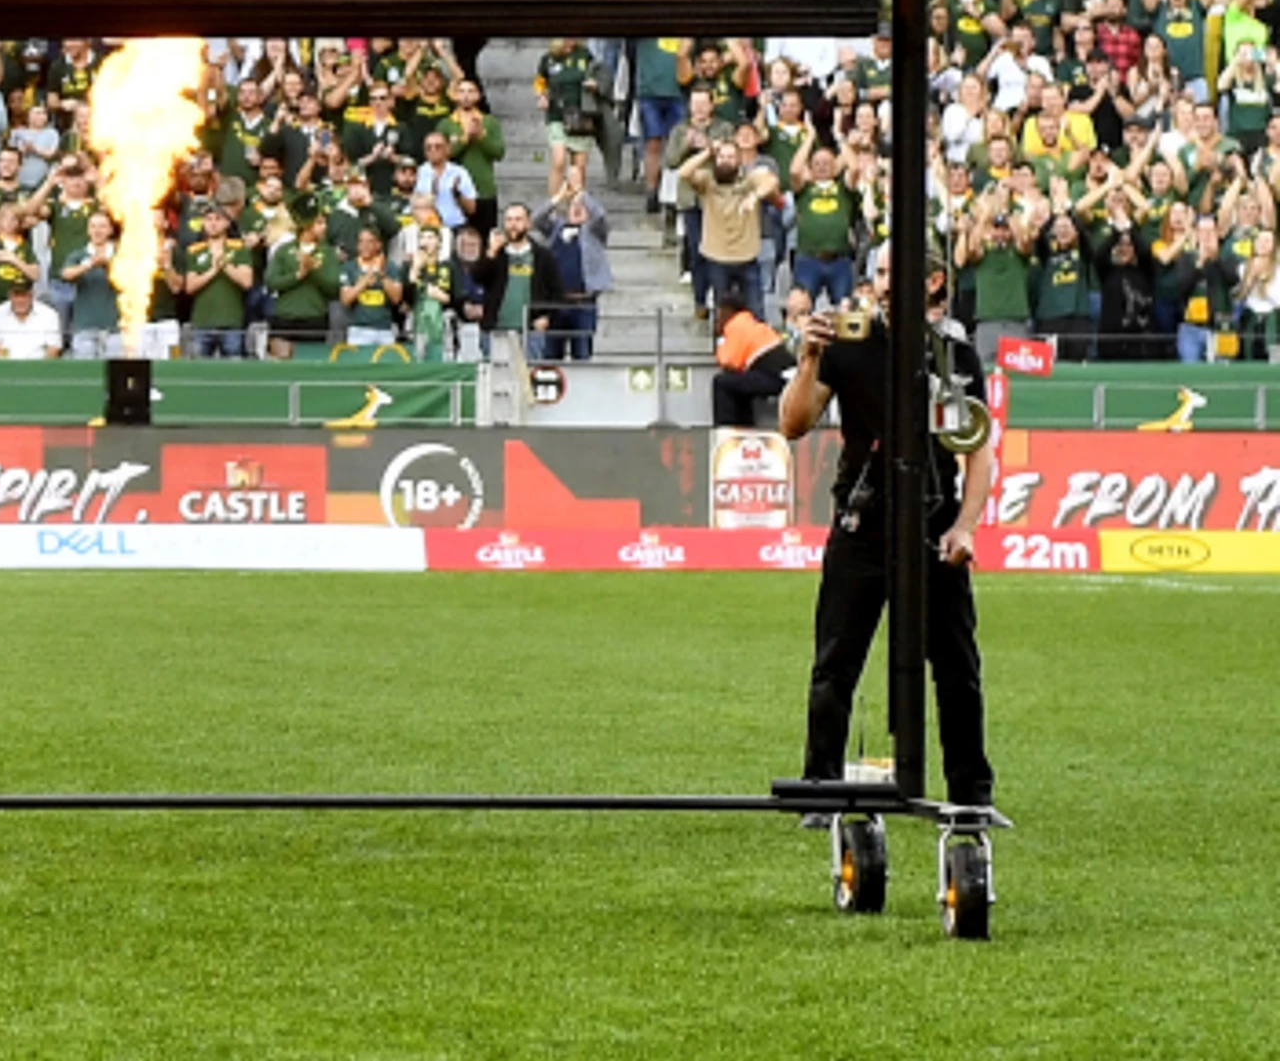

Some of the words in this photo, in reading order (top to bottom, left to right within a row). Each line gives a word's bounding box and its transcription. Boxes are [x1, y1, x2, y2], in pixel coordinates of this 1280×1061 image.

[178, 490, 306, 521] CASTLE
[398, 478, 463, 512] 18+
[715, 482, 788, 504] CASTLE
[1052, 471, 1218, 532] FROM
[38, 529, 137, 556] DELL
[475, 545, 545, 563] CASTLE
[617, 545, 686, 562] CASTLE
[1001, 534, 1089, 570] 22m
